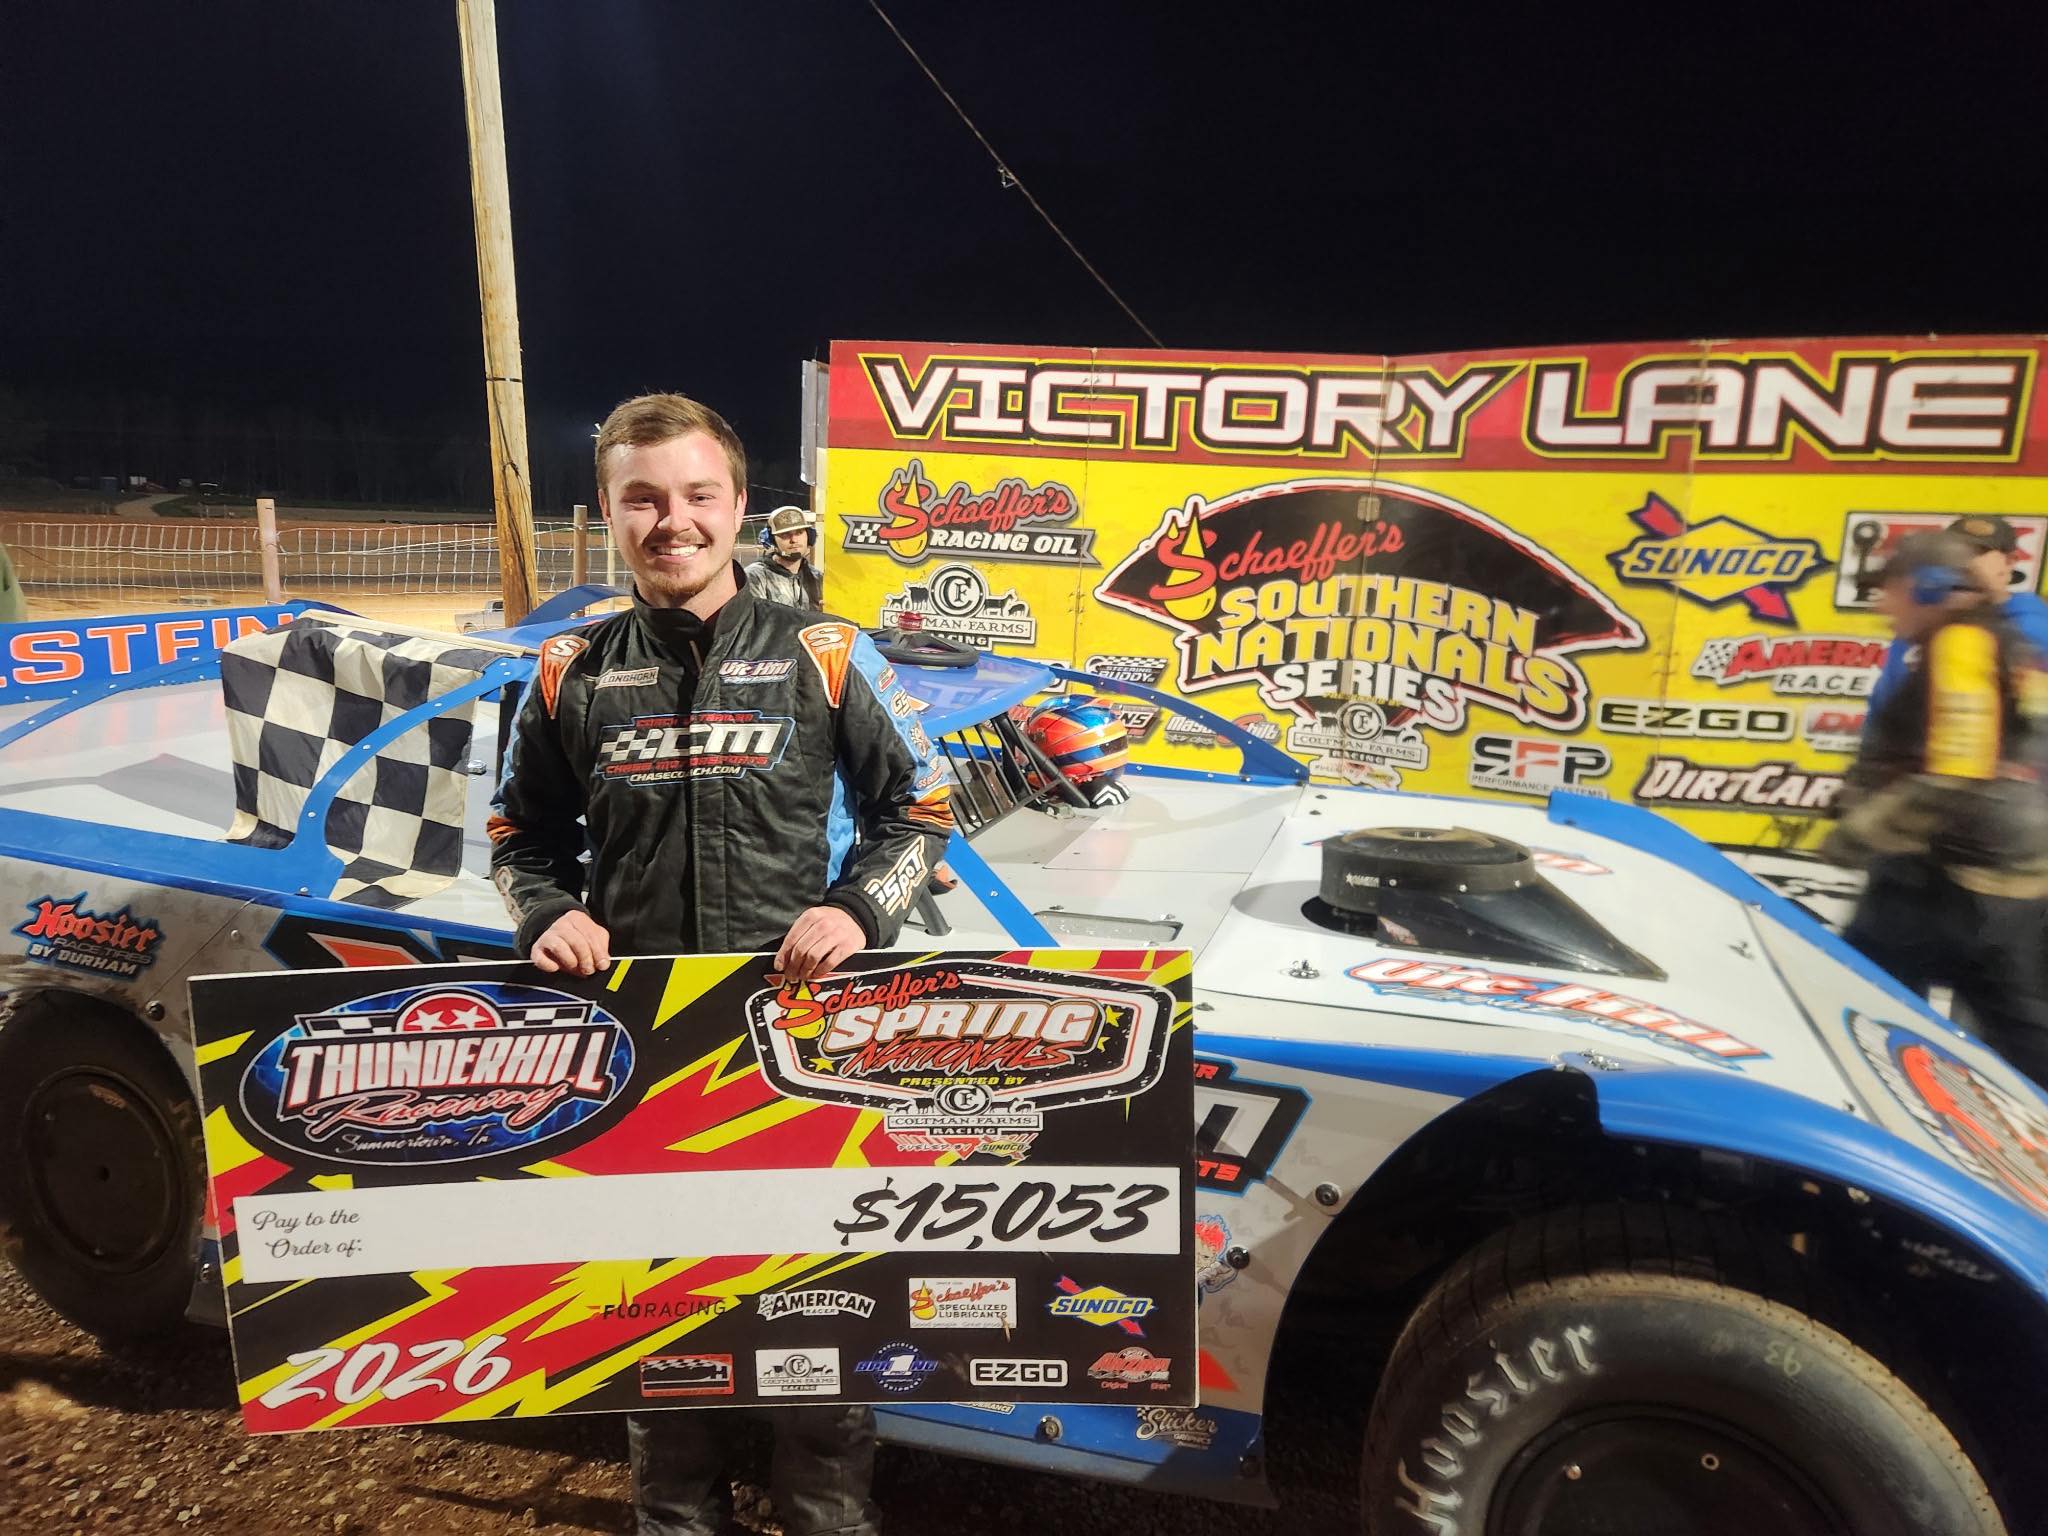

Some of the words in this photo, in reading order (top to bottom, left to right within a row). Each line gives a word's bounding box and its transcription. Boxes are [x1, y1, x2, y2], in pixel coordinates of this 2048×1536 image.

[874, 363, 1497, 447] VICTORY
[1534, 364, 2015, 448] LANE
[879, 482, 1070, 540] Schaeffer's
[929, 529, 1030, 553] RACING
[1033, 535, 1079, 555] OIL
[1149, 520, 1405, 600] Schaeffer's
[1629, 544, 1809, 577] SUNOCO
[888, 609, 964, 630] CMAN
[968, 620, 1027, 635] FARMS
[1216, 573, 1541, 657] SOUTHERN
[1191, 616, 1570, 715] NATIONALS
[1723, 639, 1888, 678] AMERI
[1270, 659, 1458, 724] SERIES
[1777, 673, 1869, 691] RACE
[1299, 735, 1365, 750] COLTMAN
[1368, 743, 1416, 759] FARMS
[1331, 751, 1385, 764] RACING
[1473, 736, 1607, 784] SFP
[1472, 774, 1549, 791] PERFORMANCE
[22, 900, 157, 953] Hoosier
[28, 943, 54, 957] BY
[58, 950, 137, 975] DURHAM
[53, 937, 102, 953] RACE
[104, 949, 152, 965] TIRES
[771, 970, 963, 1031] Schaeffer's
[831, 1002, 1096, 1052] SPRING
[286, 1030, 607, 1108] THUNDERHILL
[842, 1037, 1089, 1076] NATIONALS
[899, 1076, 1000, 1086] PRESENTED
[1004, 1076, 1027, 1085] BY
[895, 1116, 970, 1126] COLTMAN
[973, 1116, 1032, 1126] FARMS
[932, 1127, 997, 1135] RACING
[981, 1143, 1026, 1152] SUNOCO
[252, 1210, 299, 1233] Pay
[305, 1212, 326, 1226] to
[330, 1208, 361, 1225] the
[832, 1176, 1170, 1249] $15,053
[265, 1238, 333, 1259] Order
[771, 1291, 874, 1317] AMERICAN
[938, 1311, 1008, 1319] LUBRICANTS
[1055, 1298, 1148, 1314] SUNOCO
[258, 1334, 512, 1411] 2026
[1136, 1408, 1218, 1440] Sticker
